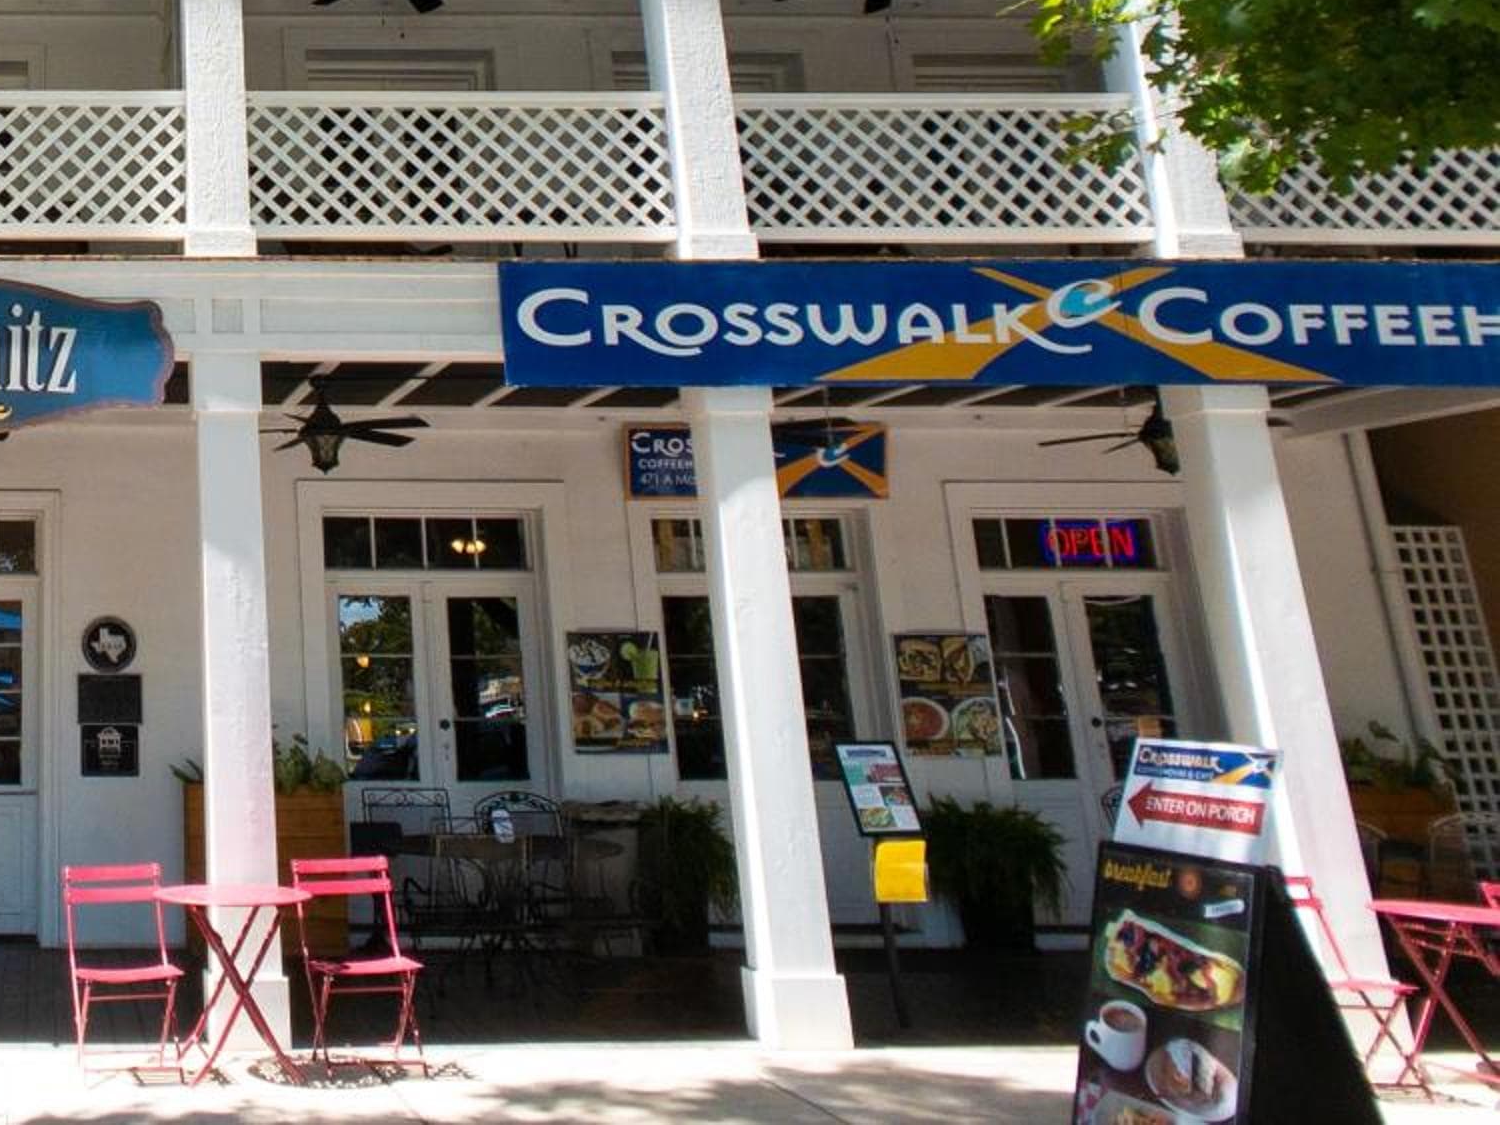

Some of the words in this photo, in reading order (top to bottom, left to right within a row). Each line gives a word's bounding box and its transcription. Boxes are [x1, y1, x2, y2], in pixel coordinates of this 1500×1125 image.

[517, 287, 1092, 354] CROSSWALK
[1045, 527, 1134, 557] OPEN
[1145, 796, 1185, 815] ENTER
[1186, 800, 1206, 817] ON
[1208, 803, 1257, 825] PORCH
